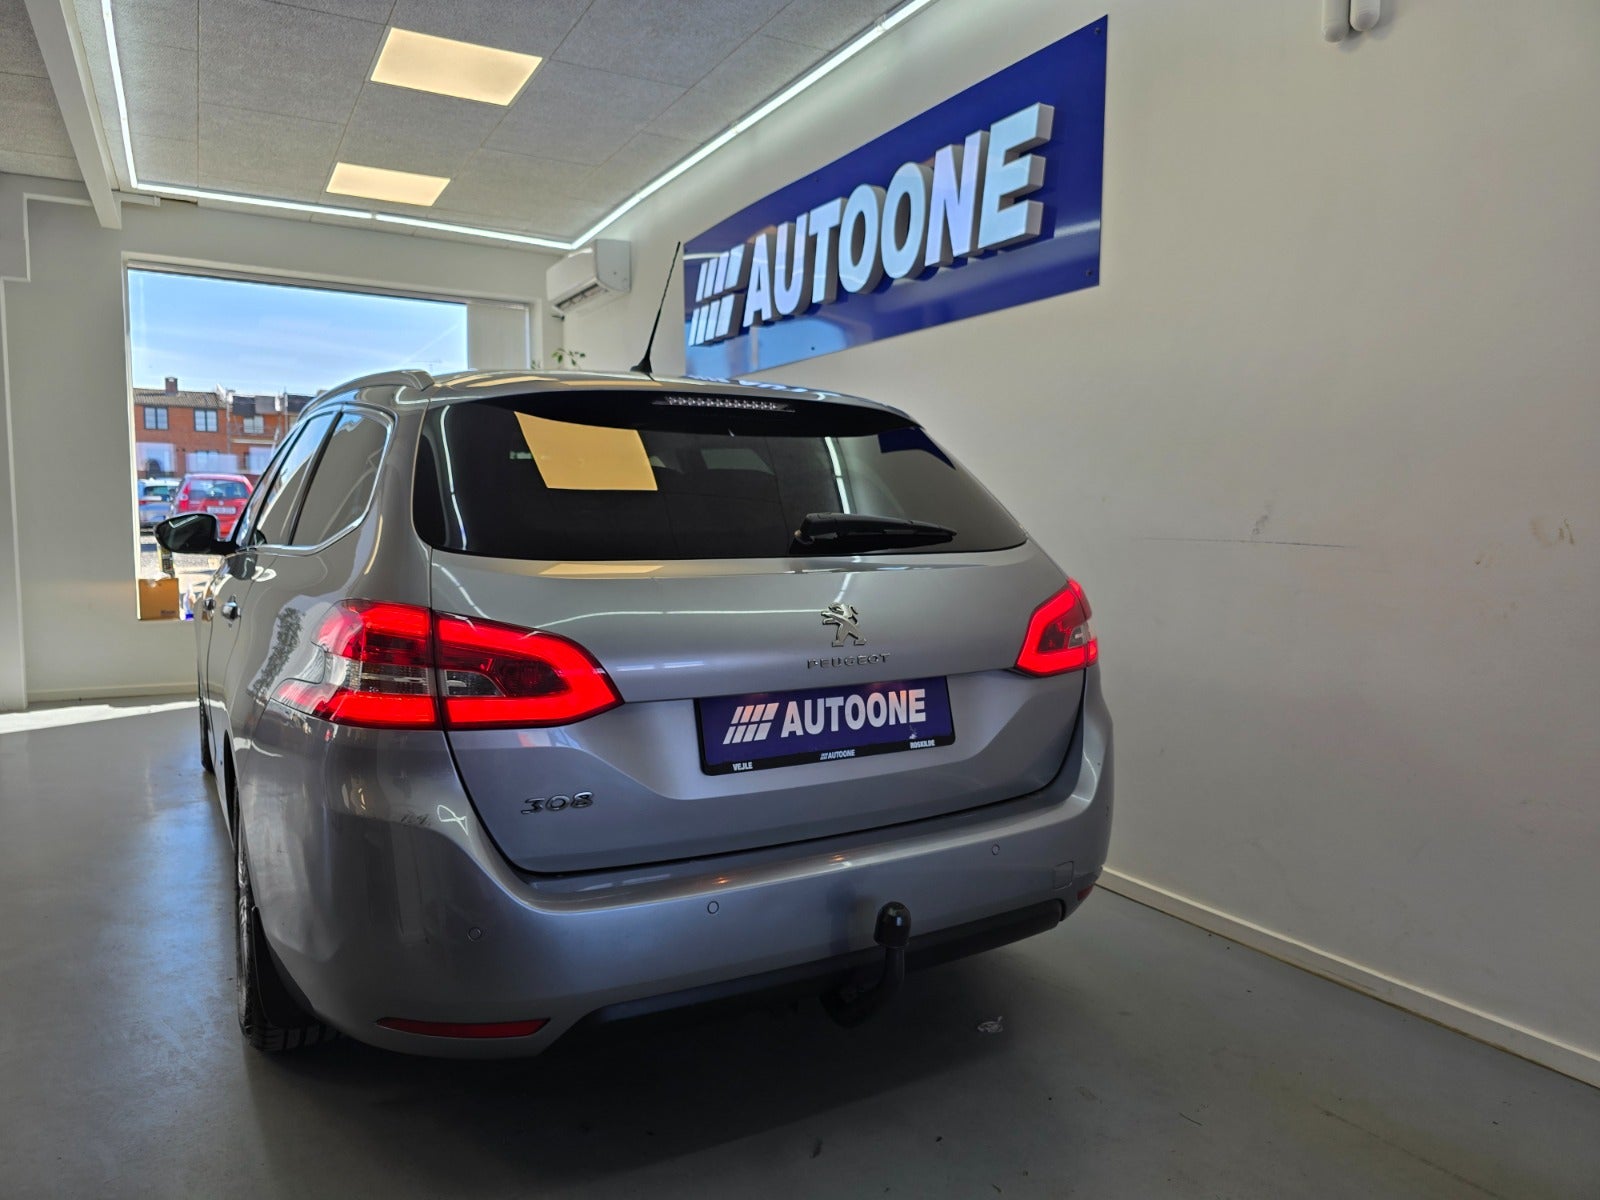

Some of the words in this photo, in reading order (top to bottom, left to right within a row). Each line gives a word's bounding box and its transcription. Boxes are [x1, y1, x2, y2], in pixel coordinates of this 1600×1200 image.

[742, 102, 1055, 328] AUTOONE
[807, 652, 891, 669] PEUGEOT
[780, 688, 926, 738] AUTOONE
[827, 749, 856, 760] AUTOONE
[732, 761, 754, 771] VEJLE
[520, 791, 593, 814] 308
